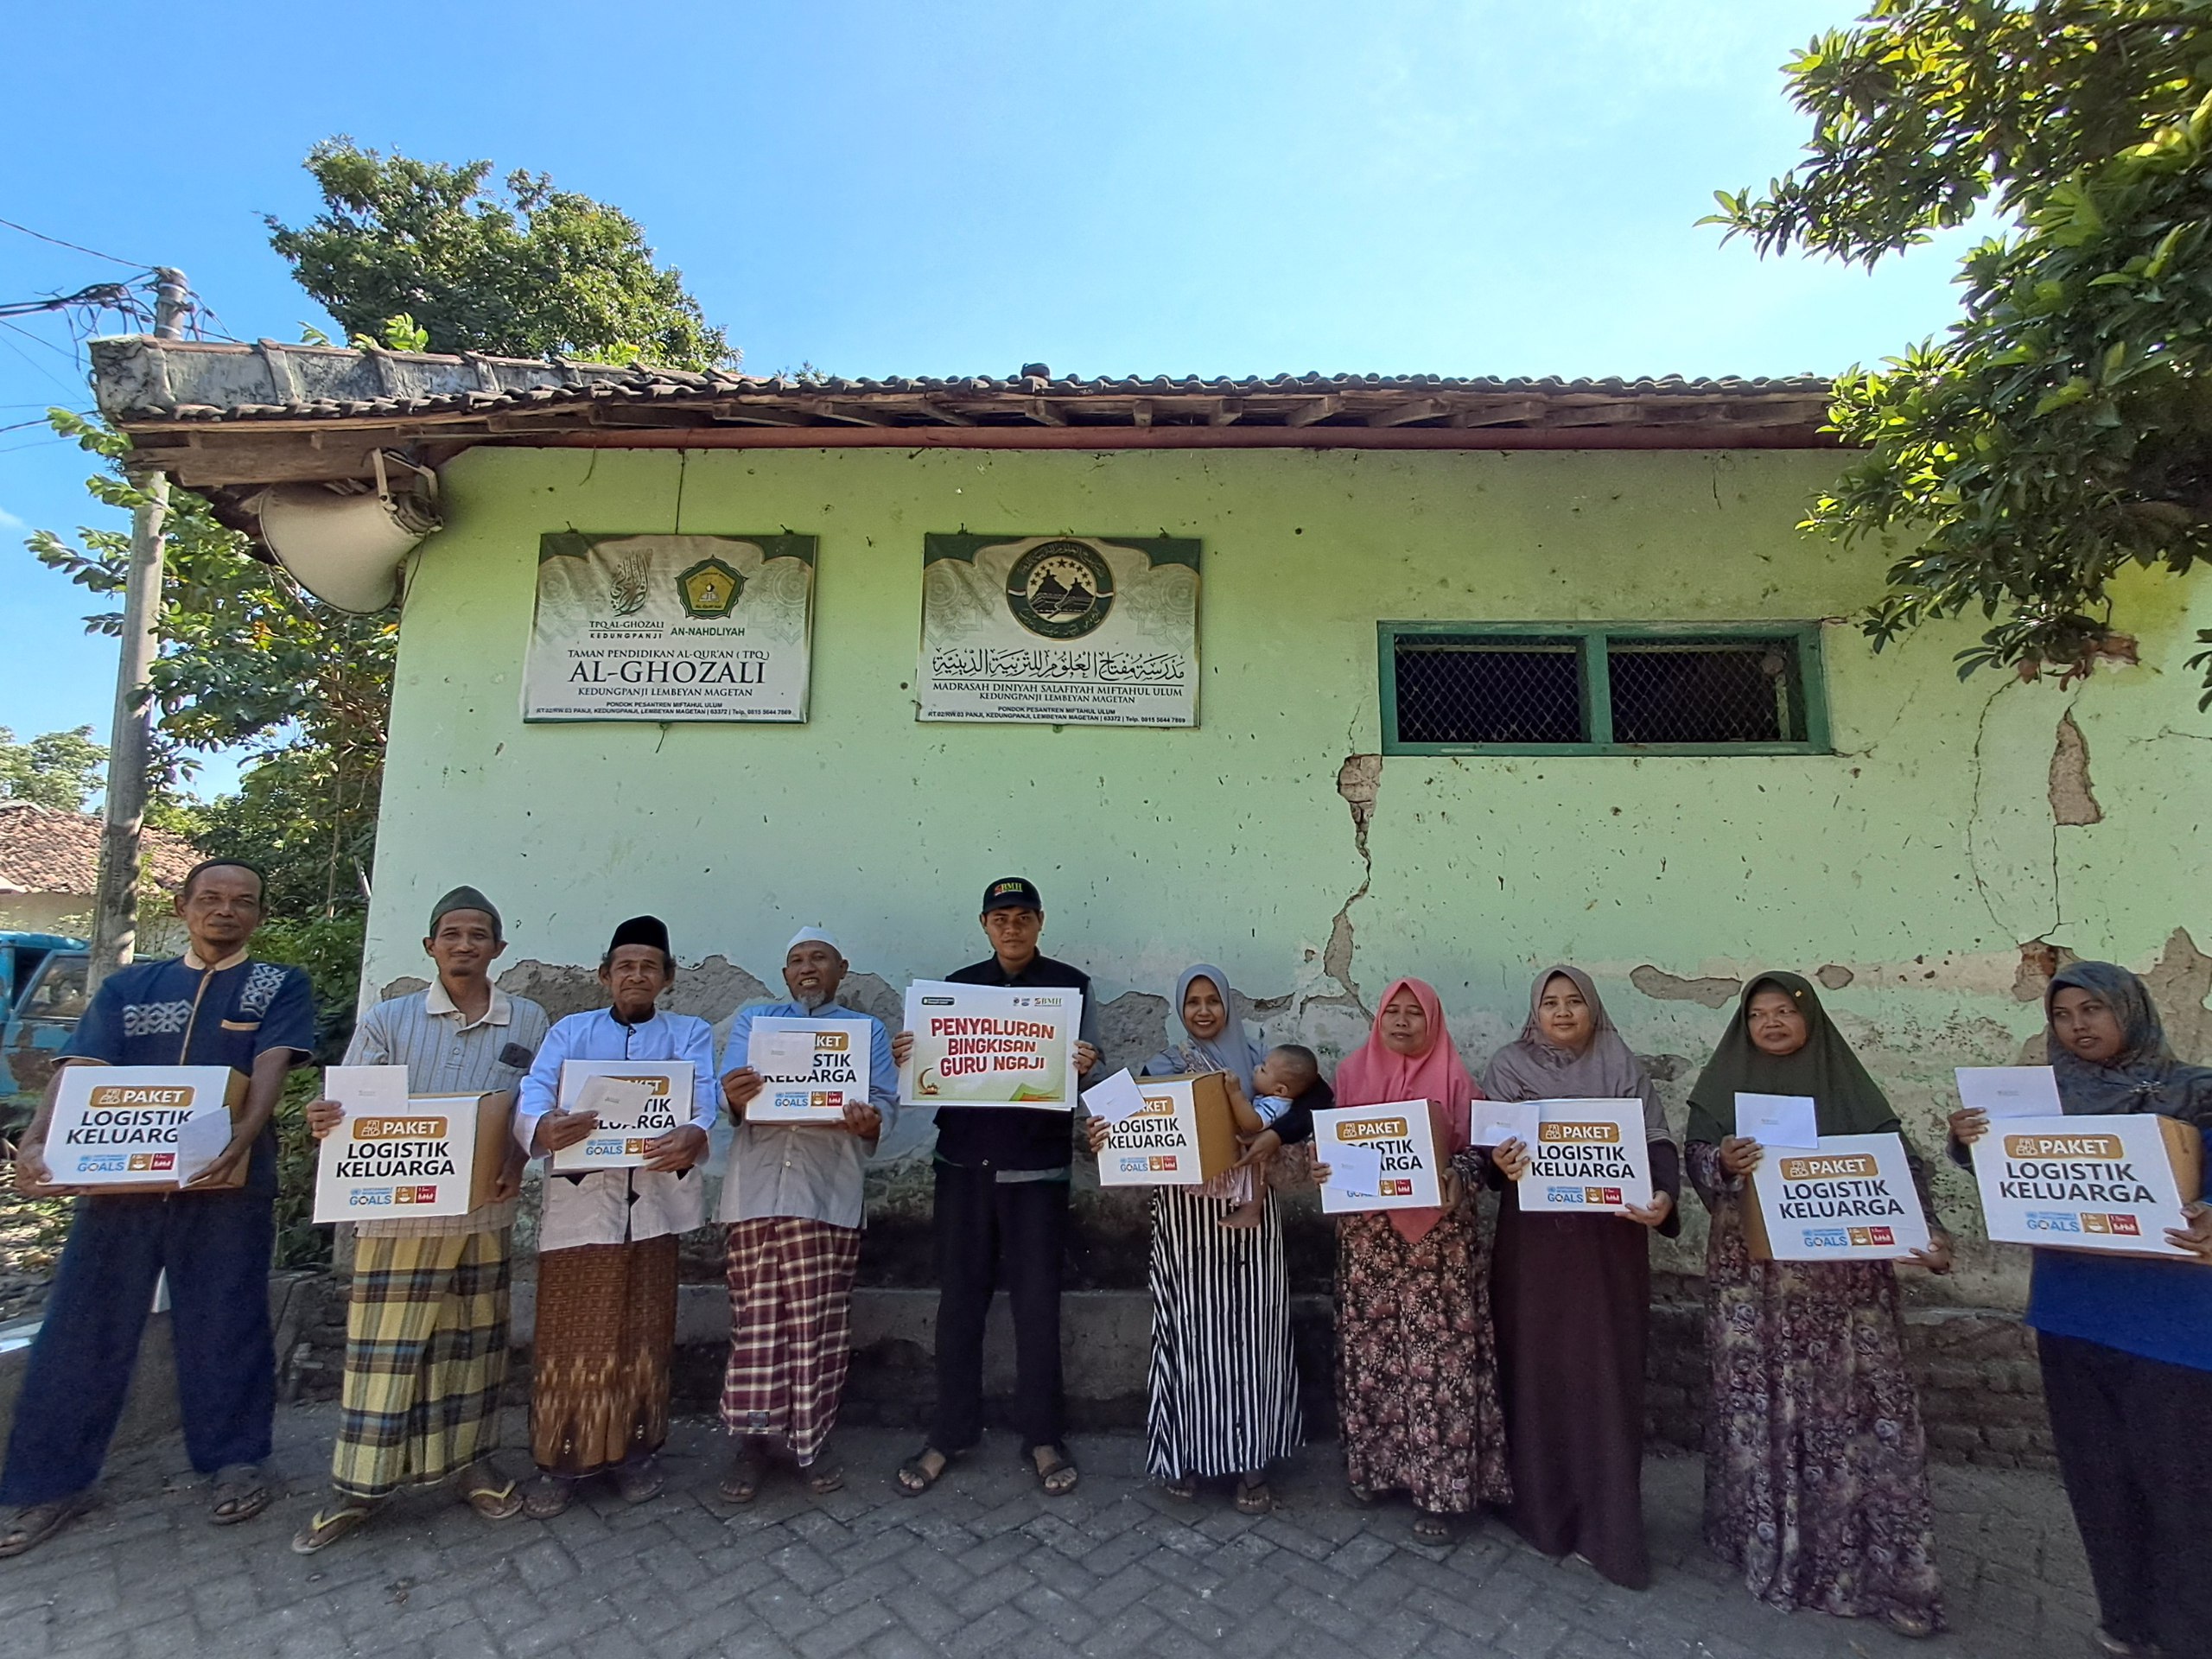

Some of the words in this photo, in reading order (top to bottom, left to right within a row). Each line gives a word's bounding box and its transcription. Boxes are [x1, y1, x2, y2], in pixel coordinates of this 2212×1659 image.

[588, 621, 608, 630] TPQ
[670, 627, 746, 637] AN-NAHDLIYAH
[567, 649, 605, 658] TAMAN
[607, 649, 675, 658] PENDIDIKAN
[677, 650, 734, 660] AL-QUR'AN
[567, 660, 766, 683] AL-GHOZALI
[578, 687, 648, 697] KEDUNGPANJI
[651, 688, 702, 696] LEMBEYAN
[703, 688, 753, 696] MAGETAN
[932, 683, 989, 691] MADRASAH
[993, 683, 1038, 693] DINIYAH
[1040, 684, 1095, 695] SALAFIYAH
[1097, 686, 1150, 696] MIFTAHUL
[1153, 688, 1183, 696] ULUM
[979, 692, 1042, 702] KEDUNGPANJI
[1045, 694, 1090, 702] LEMBEYAN
[931, 1018, 1055, 1039] PENYALURAN
[817, 1035, 842, 1047] KET
[947, 1038, 1037, 1056] BINGKISAN
[813, 1053, 852, 1067] STIK
[939, 1056, 988, 1077] GURU
[993, 1055, 1046, 1071] NGAJI
[123, 1090, 186, 1103] PAKET
[774, 1098, 809, 1107] GOALS
[81, 1110, 194, 1127] LOGISTIK
[1112, 1117, 1179, 1134] LOGISTIK
[383, 1120, 440, 1135] PAKET
[1357, 1121, 1400, 1135] PAKET
[1562, 1126, 1611, 1139] PAKET
[66, 1128, 178, 1145] KELUARG
[1108, 1133, 1187, 1149] KELUARGA
[347, 1141, 450, 1160] LOGISTIK
[586, 1146, 623, 1156] GOALS
[1538, 1145, 1626, 1161] LOGISTIK
[2039, 1139, 2109, 1154] PAKET
[76, 1161, 125, 1173] GOALS
[335, 1159, 456, 1178] KELUARGA
[1120, 1163, 1148, 1173] GOALS
[1531, 1162, 1636, 1179] KELUARGA
[1809, 1158, 1866, 1175] PAKET
[2005, 1161, 2139, 1182] LOGISTIK
[1783, 1179, 1891, 1200] LOGISTIK
[1999, 1181, 2158, 1204] KELUARGA
[349, 1195, 392, 1206] GOALS
[1548, 1193, 1584, 1203] GOALS
[1778, 1198, 1905, 1219] KELUARGA
[2025, 1219, 2081, 1233] GOALS
[1803, 1236, 1848, 1247] GOALS
